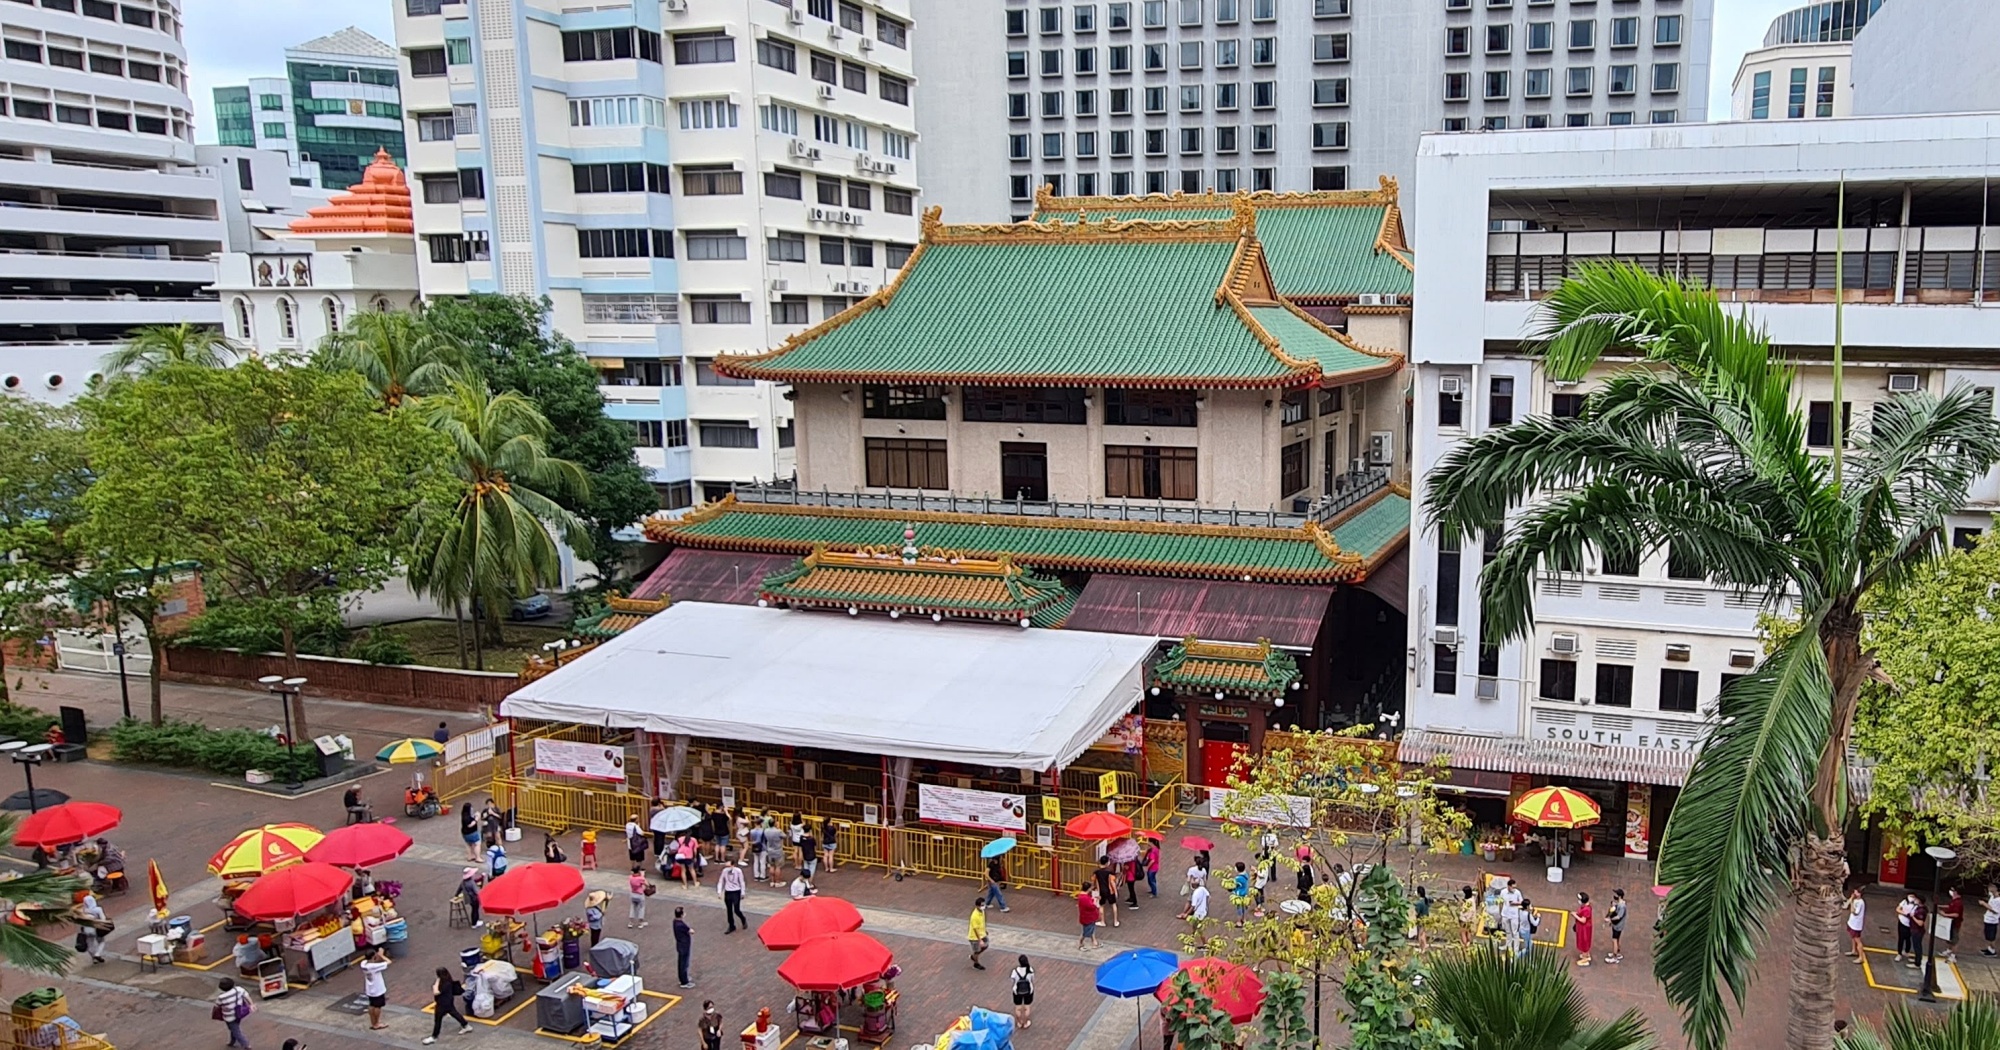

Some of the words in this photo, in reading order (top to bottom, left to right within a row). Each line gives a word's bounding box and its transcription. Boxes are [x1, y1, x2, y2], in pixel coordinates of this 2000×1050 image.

[1547, 727, 1621, 744] SOUTH
[1639, 735, 1698, 751] EAST
[1104, 784, 1113, 795] IN
[1047, 808, 1057, 818] IN
